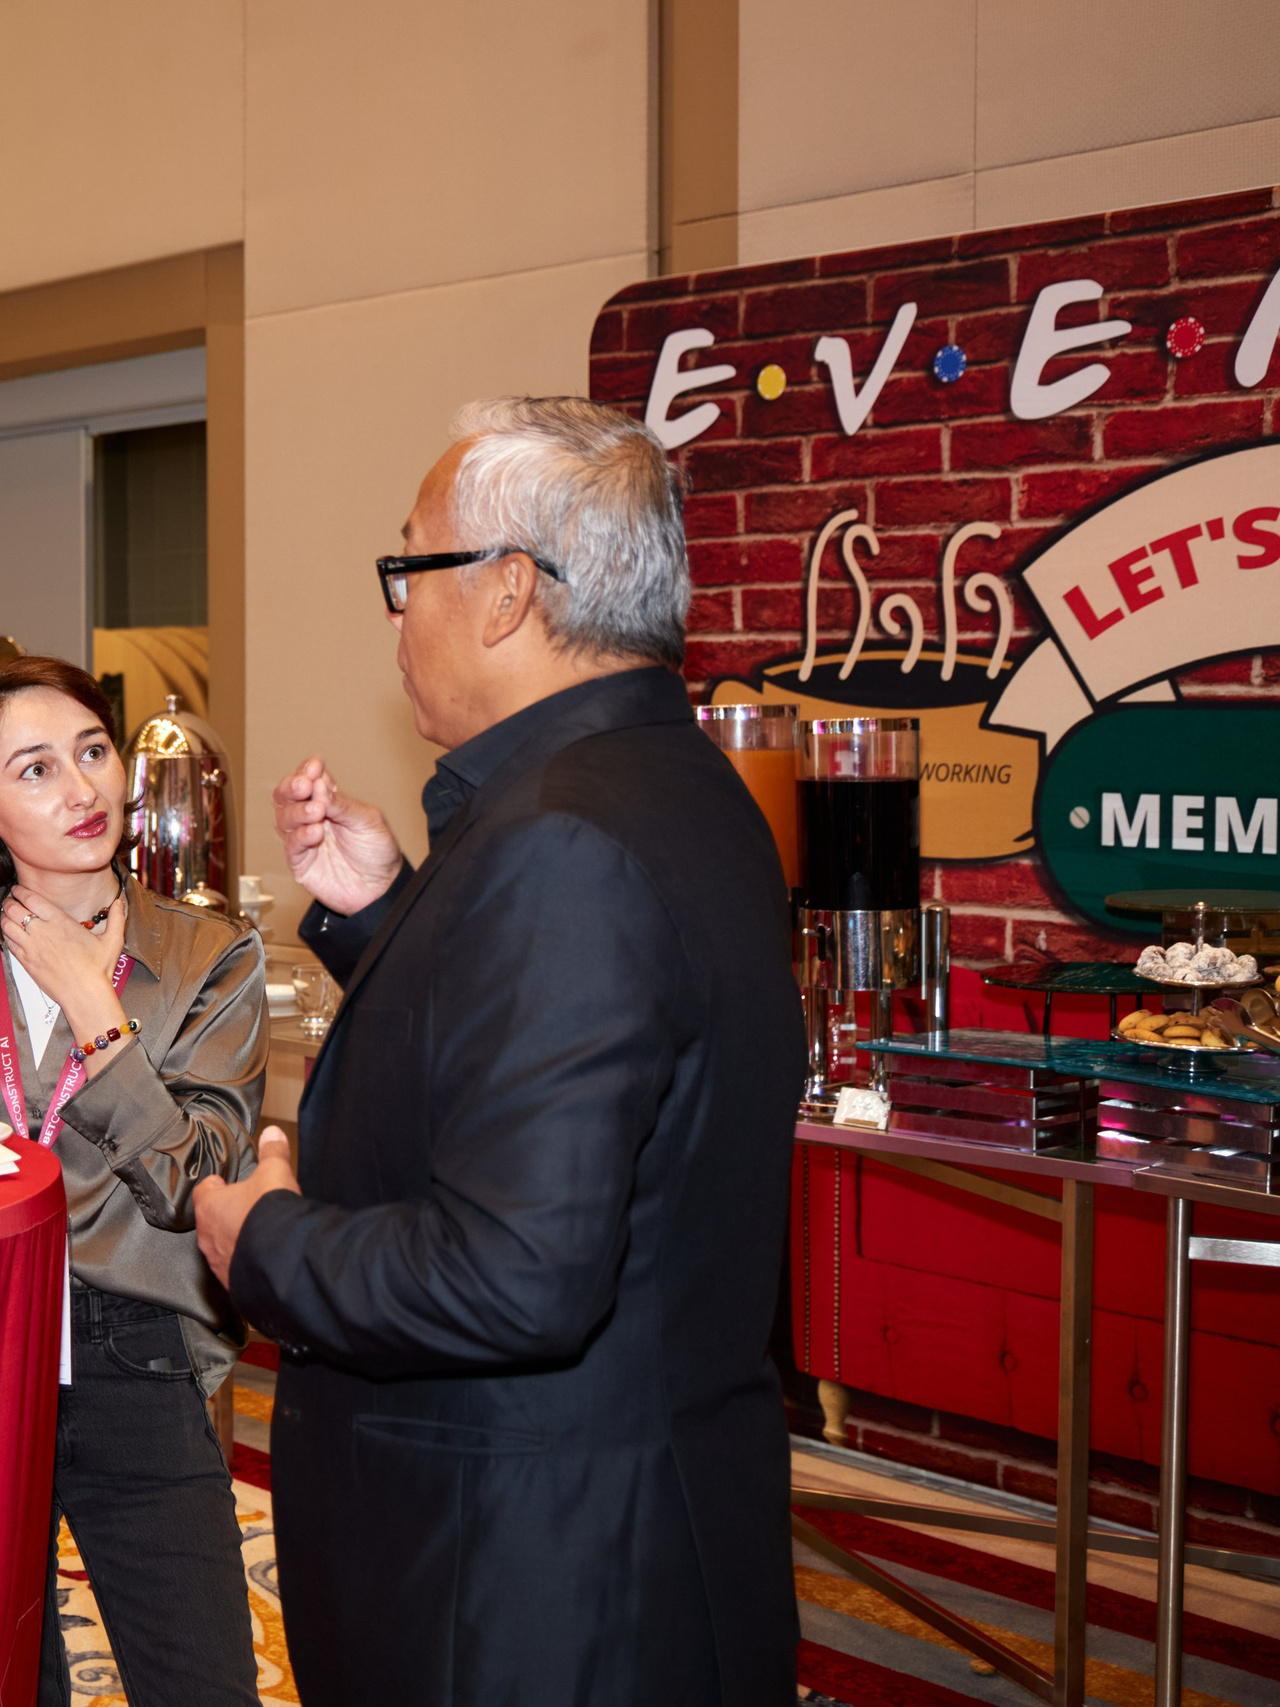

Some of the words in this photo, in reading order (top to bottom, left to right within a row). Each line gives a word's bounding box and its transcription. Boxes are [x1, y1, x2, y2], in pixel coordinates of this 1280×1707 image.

[1062, 506, 1280, 641] LET'S
[1101, 792, 1278, 855] MEM
[0, 1036, 10, 1048] AI
